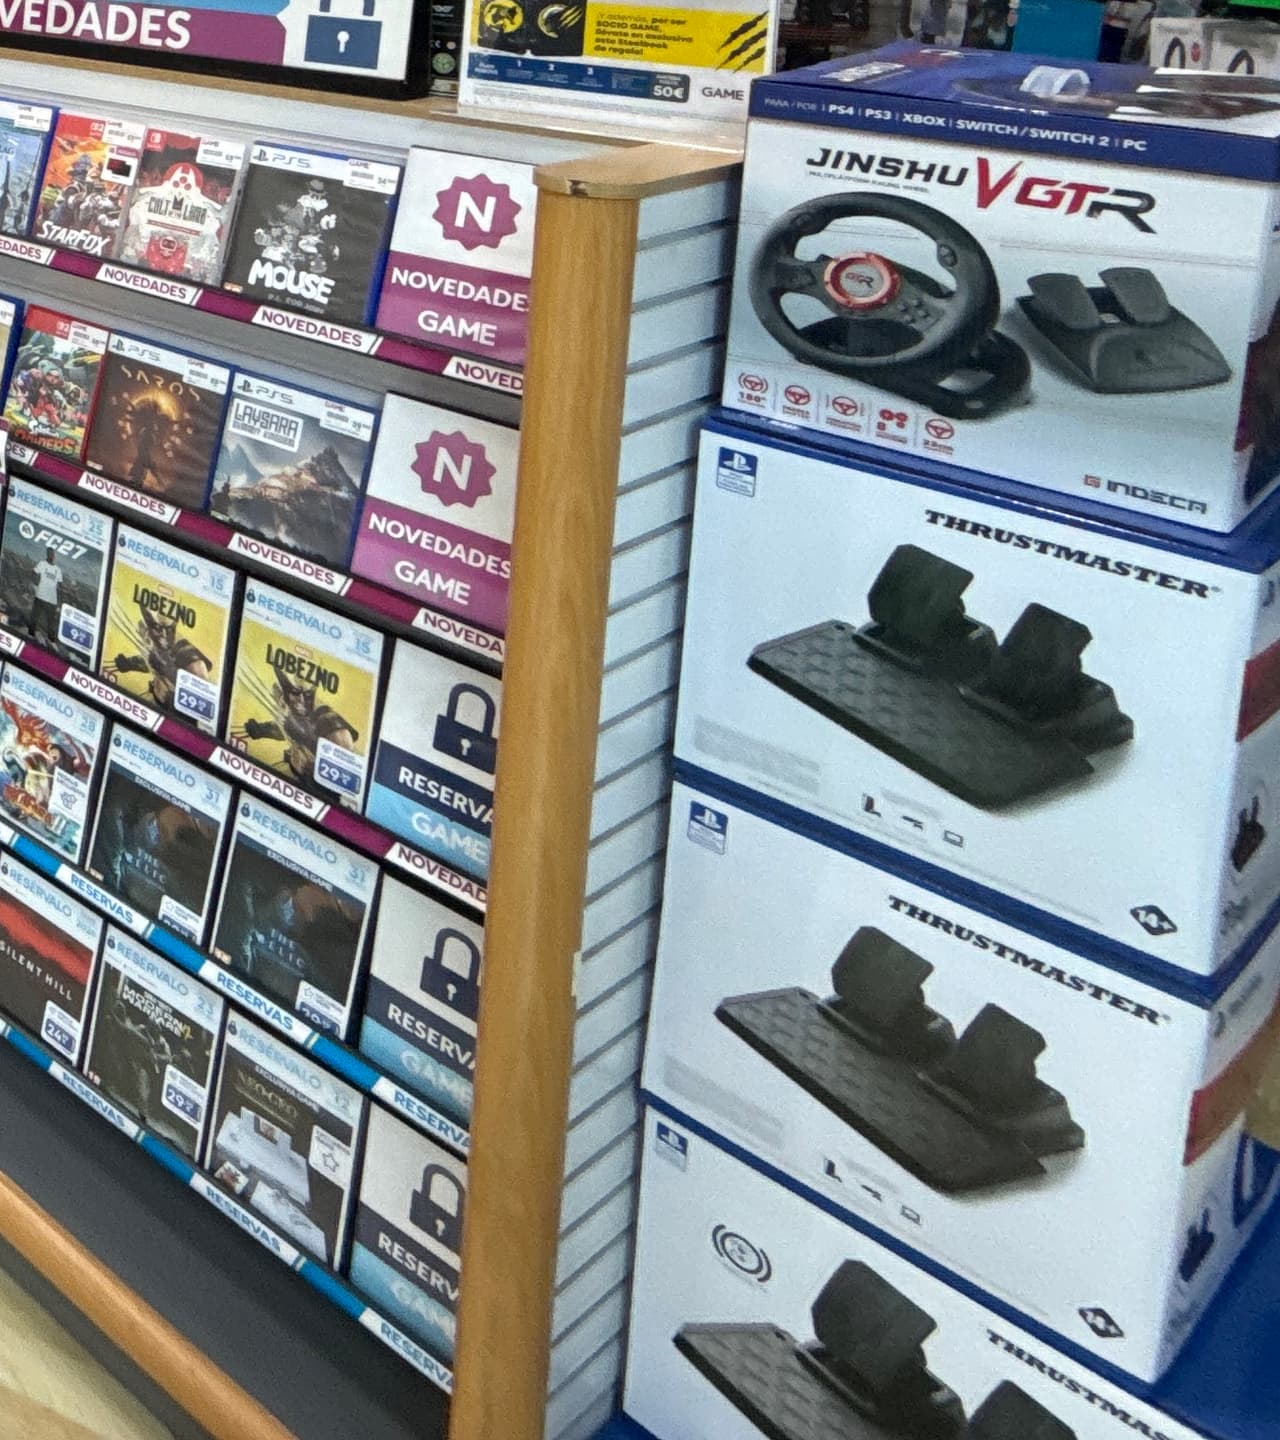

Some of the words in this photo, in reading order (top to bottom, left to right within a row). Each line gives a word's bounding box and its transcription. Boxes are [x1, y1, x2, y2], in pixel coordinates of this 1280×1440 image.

[653, 85, 685, 99] 50€
[702, 87, 745, 101] GAME
[828, 104, 855, 116] PS4
[864, 108, 892, 120] PS3
[902, 112, 947, 127] XBOX
[1097, 135, 1110, 148] 2
[1123, 138, 1148, 152] PC
[271, 154, 314, 170] PS5
[806, 146, 970, 188] JINSHU
[103, 266, 188, 301] NOVEDADES
[248, 260, 336, 305] MOUSE
[260, 310, 363, 349] NOVEDADES
[417, 310, 499, 348] GAME
[255, 385, 294, 405] PS5
[233, 402, 300, 440] LAYSARA
[84, 475, 167, 517] NOVEDADES
[34, 528, 88, 560] FC27
[127, 538, 200, 579] RESÉRVALO
[236, 536, 336, 587] NOVEDADES
[368, 513, 512, 580] NOVEDADES
[924, 508, 1213, 599] THRUSTMASTER
[132, 584, 196, 629] LOBEZNO
[394, 562, 471, 606] GAME
[256, 592, 342, 641] RESÉRVALO
[266, 643, 340, 695] LOBEZNO
[69, 671, 148, 722] NOVEDADES
[219, 752, 314, 810] NOVEDADES
[410, 812, 490, 859] GAME
[70, 872, 134, 924] RESERVAS
[888, 894, 1164, 1026] THRUSTMASTER
[44, 976, 74, 1002] HILL
[217, 970, 295, 1032] RESERVAS
[62, 1070, 125, 1128] RESERVAS
[206, 1185, 281, 1251] RESERVAS
